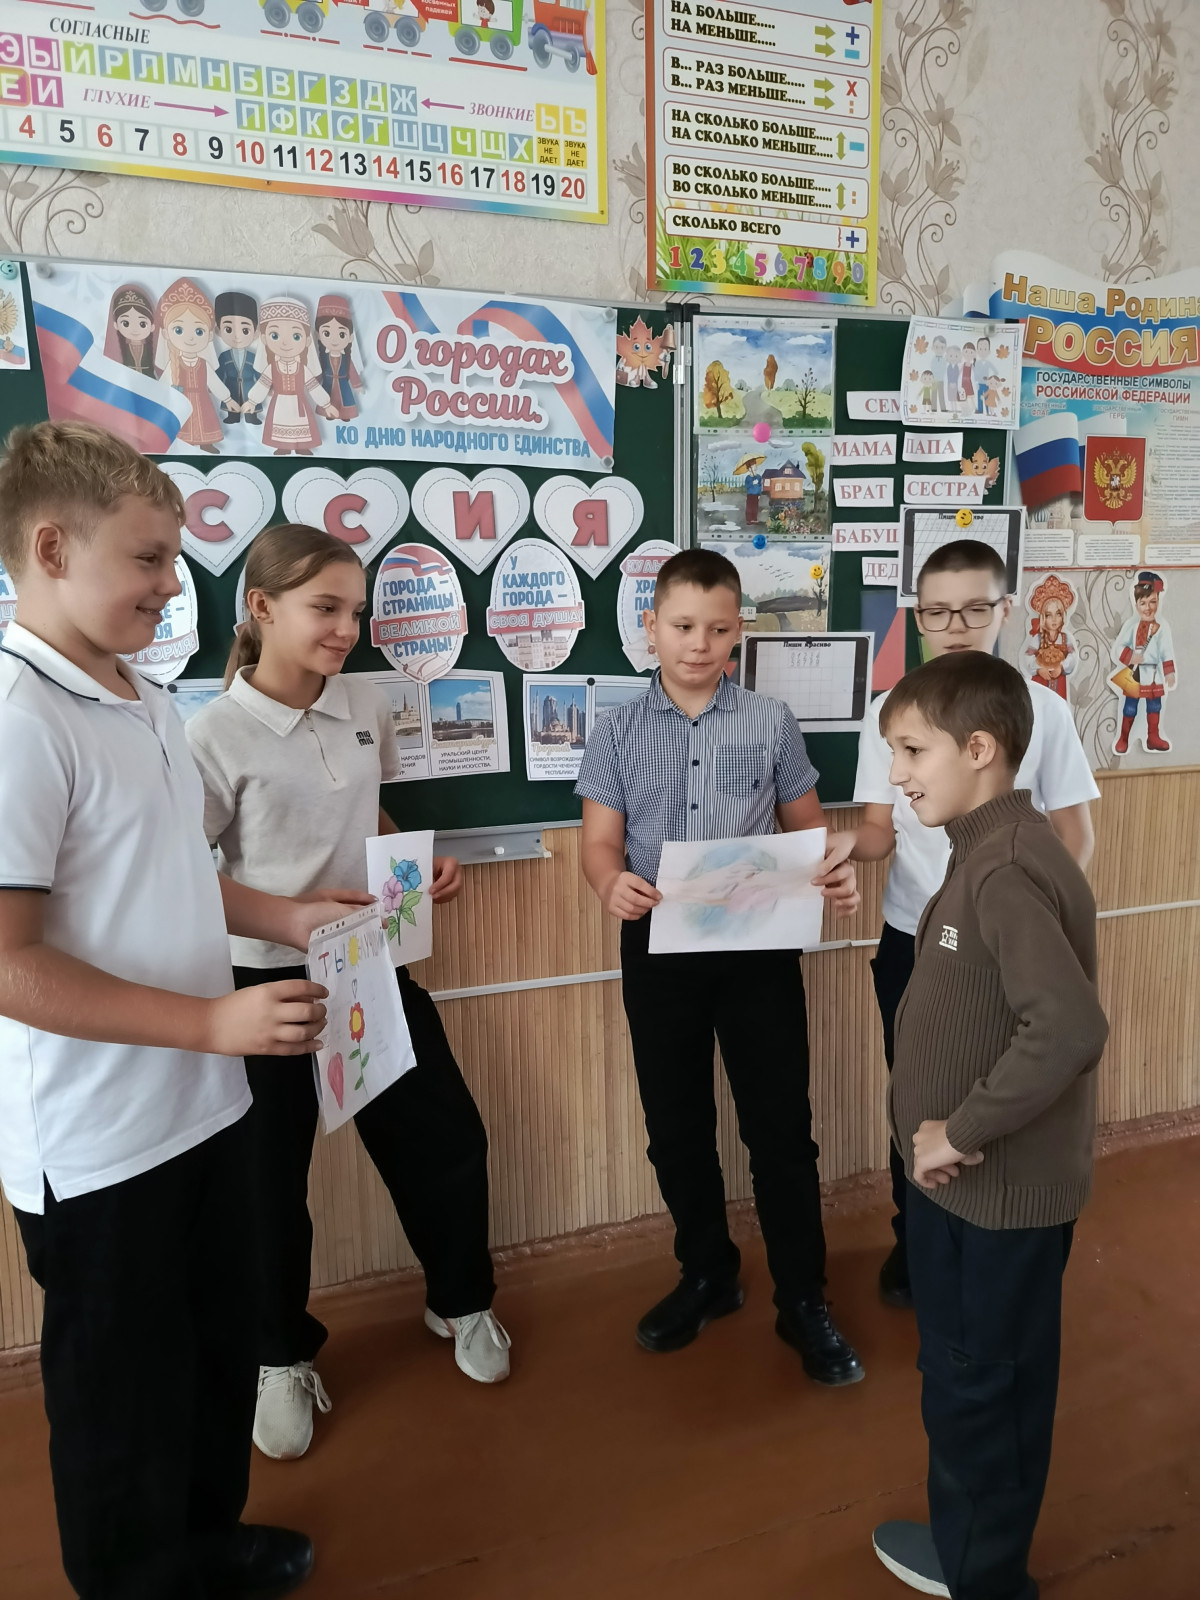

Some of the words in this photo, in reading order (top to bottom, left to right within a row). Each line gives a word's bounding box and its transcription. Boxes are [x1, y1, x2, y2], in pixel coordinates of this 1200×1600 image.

[671, 0, 692, 15] НА
[50, 16, 150, 45] СОГЛАСНЫЕ
[671, 18, 692, 33] НА
[696, 60, 724, 75] РАЗ
[696, 78, 724, 93] РАЗ
[83, 88, 151, 109] ГЛУХИЕ
[469, 102, 535, 123] ЗВОНКИЕ
[672, 109, 691, 123] НА
[695, 112, 758, 131] СКОЛЬКО
[537, 136, 560, 147] ЗВУКА
[564, 140, 586, 150] ЗВУКА
[672, 126, 691, 140] НА
[695, 129, 758, 148] СКОЛЬКО
[19, 115, 35, 138] 4
[59, 119, 75, 143] 5
[97, 123, 113, 147] 6
[134, 128, 150, 151] 7
[172, 132, 187, 156] 8
[208, 136, 224, 160] 9
[235, 139, 265, 165] 10
[273, 144, 298, 169] 11
[305, 147, 333, 173] 12
[339, 151, 367, 176] 13
[372, 154, 400, 179] 14
[405, 159, 432, 183] 15
[438, 162, 464, 186] 16
[470, 166, 495, 189] 17
[501, 169, 526, 193] 18
[531, 173, 556, 196] 19
[561, 176, 585, 200] 20
[539, 155, 558, 165] ДАЕТ
[543, 147, 553, 155] НЕ
[570, 150, 580, 158] НЕ
[566, 158, 585, 168] ДАЕТ
[673, 163, 690, 176] ВО
[694, 165, 757, 183] СКОЛЬКО
[673, 180, 690, 193] ВО
[694, 183, 757, 200] СКОЛЬКО
[673, 215, 737, 231] СКОЛЬКО
[741, 222, 781, 236] ВСЕГО
[669, 246, 682, 268] 1
[690, 248, 704, 270] 2
[711, 249, 726, 274] 3
[733, 250, 747, 276] 4
[754, 252, 768, 277] 5
[775, 252, 787, 276] 6
[794, 256, 807, 282] 7
[813, 256, 826, 280] 8
[833, 261, 845, 285] 9
[852, 262, 864, 283] 0
[1003, 272, 1096, 314] Наша
[1105, 288, 1200, 324] Родин
[1024, 316, 1198, 366] РОССИЯ
[376, 324, 407, 363] О
[414, 338, 568, 387] городах
[1036, 371, 1139, 388] ГОСУДАРСТВЕННЫЕ
[1142, 377, 1191, 390] СИМВОЛЫ
[392, 376, 543, 424] России.
[1036, 384, 1118, 401] РОССИЙСКОЙ
[1122, 389, 1191, 404] ФЕДЕРАЦИИ
[865, 398, 900, 413] СЕМ
[336, 425, 358, 445] КО
[365, 426, 405, 448] ДНЮ
[411, 428, 508, 453] НАРОДНОГО
[514, 434, 591, 458] ЕДИНСТВА
[832, 441, 893, 457] МАМА
[906, 439, 956, 454] ПАПА
[840, 484, 887, 500] БРАТ
[907, 481, 980, 497] СЕСТРА
[185, 488, 235, 543] С
[323, 493, 371, 545] С
[452, 491, 497, 539] И
[572, 499, 608, 547] Я
[835, 528, 900, 544] БАБУШ
[510, 556, 517, 570] У
[864, 563, 899, 579] ДЕД
[382, 577, 436, 597] ГОРОДА
[502, 571, 565, 589] КАЖДОГО
[382, 592, 454, 616] СТРАНИЦЫ
[502, 589, 553, 607] ГОРОДА
[379, 612, 461, 640] ВЕЛИКОЙ
[489, 613, 529, 628] СВОЯ
[532, 609, 584, 628] ДУША!
[393, 636, 452, 658] СТРАНЫ!
